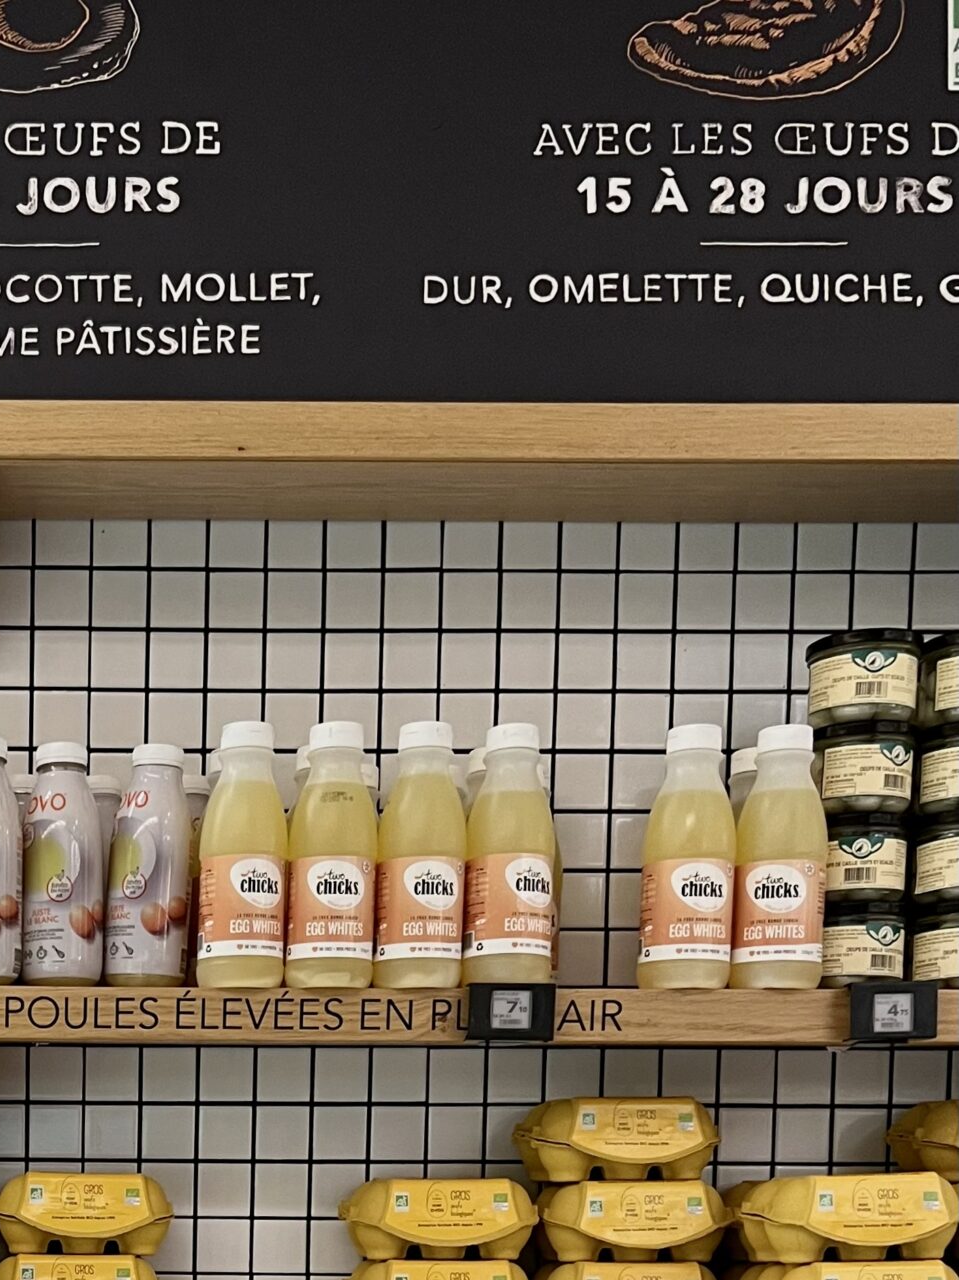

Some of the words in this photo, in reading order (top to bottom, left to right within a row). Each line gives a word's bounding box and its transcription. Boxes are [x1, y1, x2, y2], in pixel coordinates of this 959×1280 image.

[5, 122, 140, 156] ŒUFS
[161, 121, 220, 154] DE
[534, 122, 651, 155] AVEC
[672, 123, 752, 155] LES
[775, 122, 909, 156] ŒUFS
[16, 177, 179, 215] JOURS
[577, 177, 631, 213] 15
[652, 168, 688, 212] À
[710, 177, 765, 214] 28
[785, 176, 953, 213] JOURS
[162, 273, 320, 305] MOLLET,
[424, 276, 512, 308] DUR,
[529, 273, 744, 307] OMELETTE,
[761, 273, 923, 306] QUICHE,
[57, 318, 259, 355] PÂTISSIÈRE
[27, 793, 66, 814] OVO
[240, 878, 279, 894] chicks
[317, 878, 359, 896] chicks
[414, 879, 454, 896] chicks
[516, 877, 550, 894] chicks
[682, 881, 723, 898] chicks
[754, 882, 800, 900] chicks
[230, 920, 251, 934] EGG
[306, 921, 325, 936] EGG
[327, 921, 363, 936] WHITES
[403, 922, 423, 936] EGG
[425, 922, 457, 936] WHITES
[504, 918, 525, 932] EGG
[669, 923, 690, 938] EGG
[693, 924, 726, 938] WHITES
[744, 925, 763, 939] EGG
[765, 924, 805, 938] WHITES
[5, 996, 158, 1029] POULES
[176, 990, 344, 1031] ÉLEVÉES
[361, 999, 413, 1030] EN
[555, 998, 624, 1033] AIR
[506, 1000, 519, 1014] 7
[888, 1004, 899, 1016] 4
[84, 1184, 103, 1195] GROS
[450, 1190, 470, 1202] GROS
[644, 1194, 665, 1206] GROS
[74, 1264, 94, 1276] GROS
